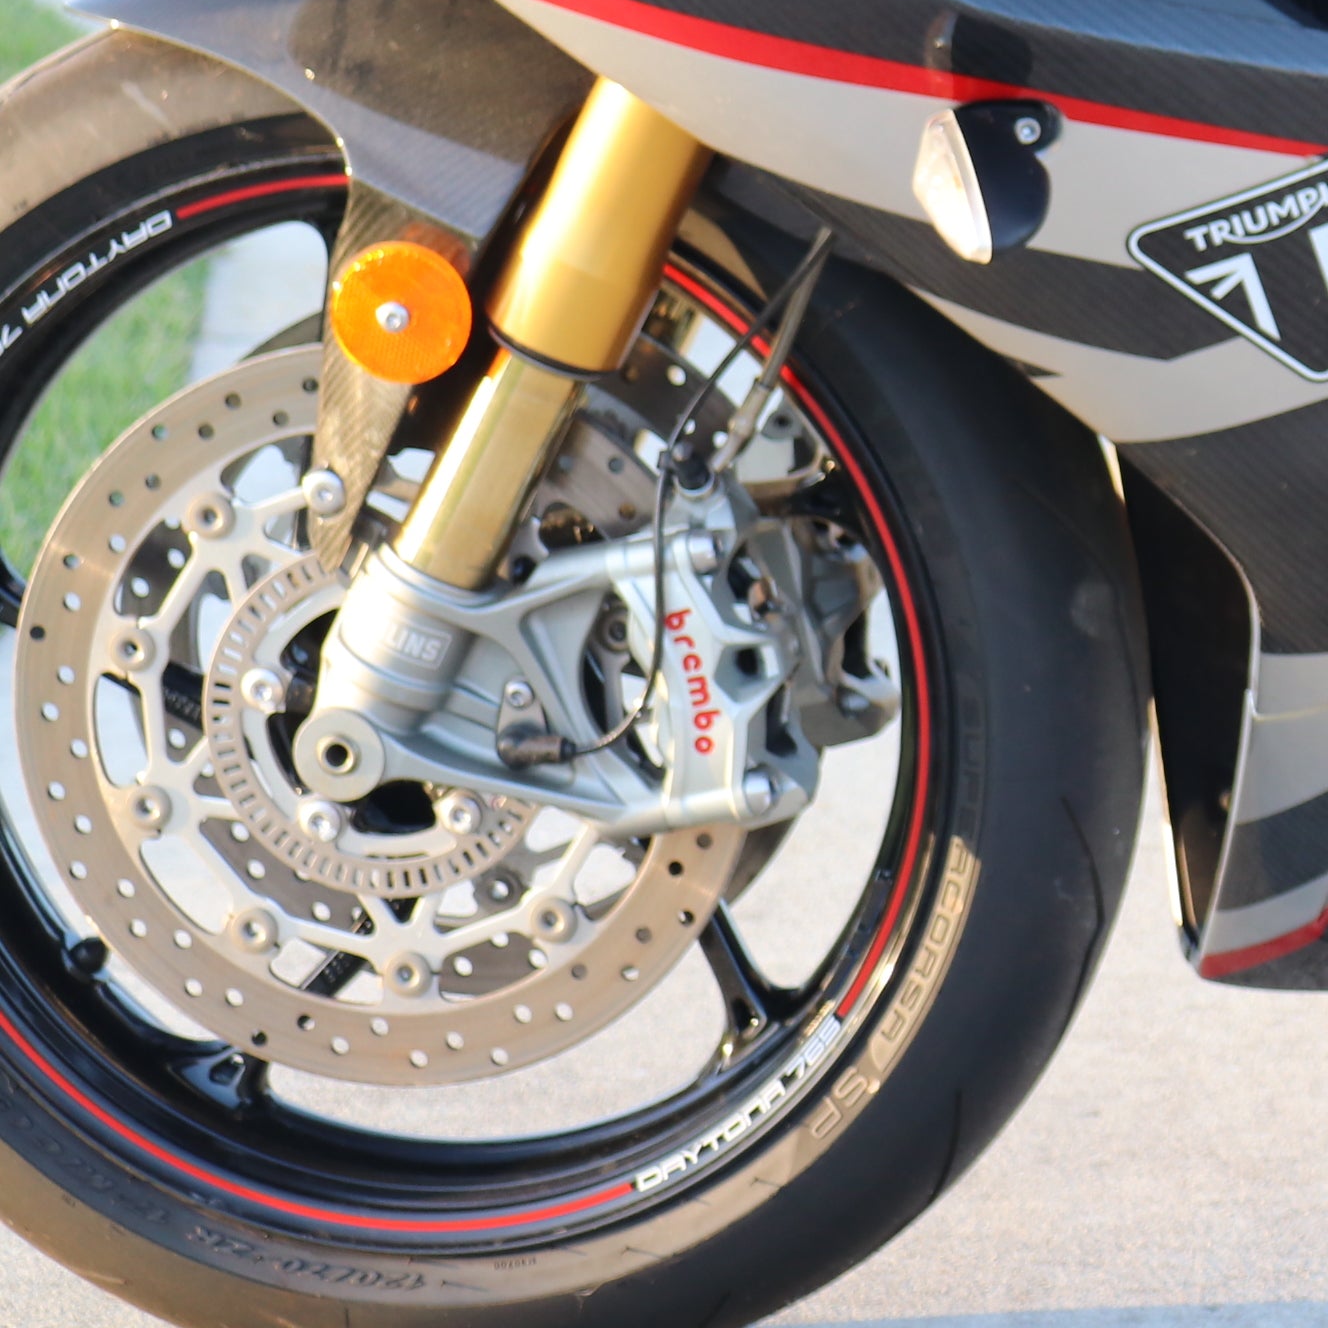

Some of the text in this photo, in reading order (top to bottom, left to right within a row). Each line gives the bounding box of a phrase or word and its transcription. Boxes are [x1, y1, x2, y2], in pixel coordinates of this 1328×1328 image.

[21, 209, 172, 324] DAYTONA
[635, 1015, 843, 1193] DAYTONA 765
